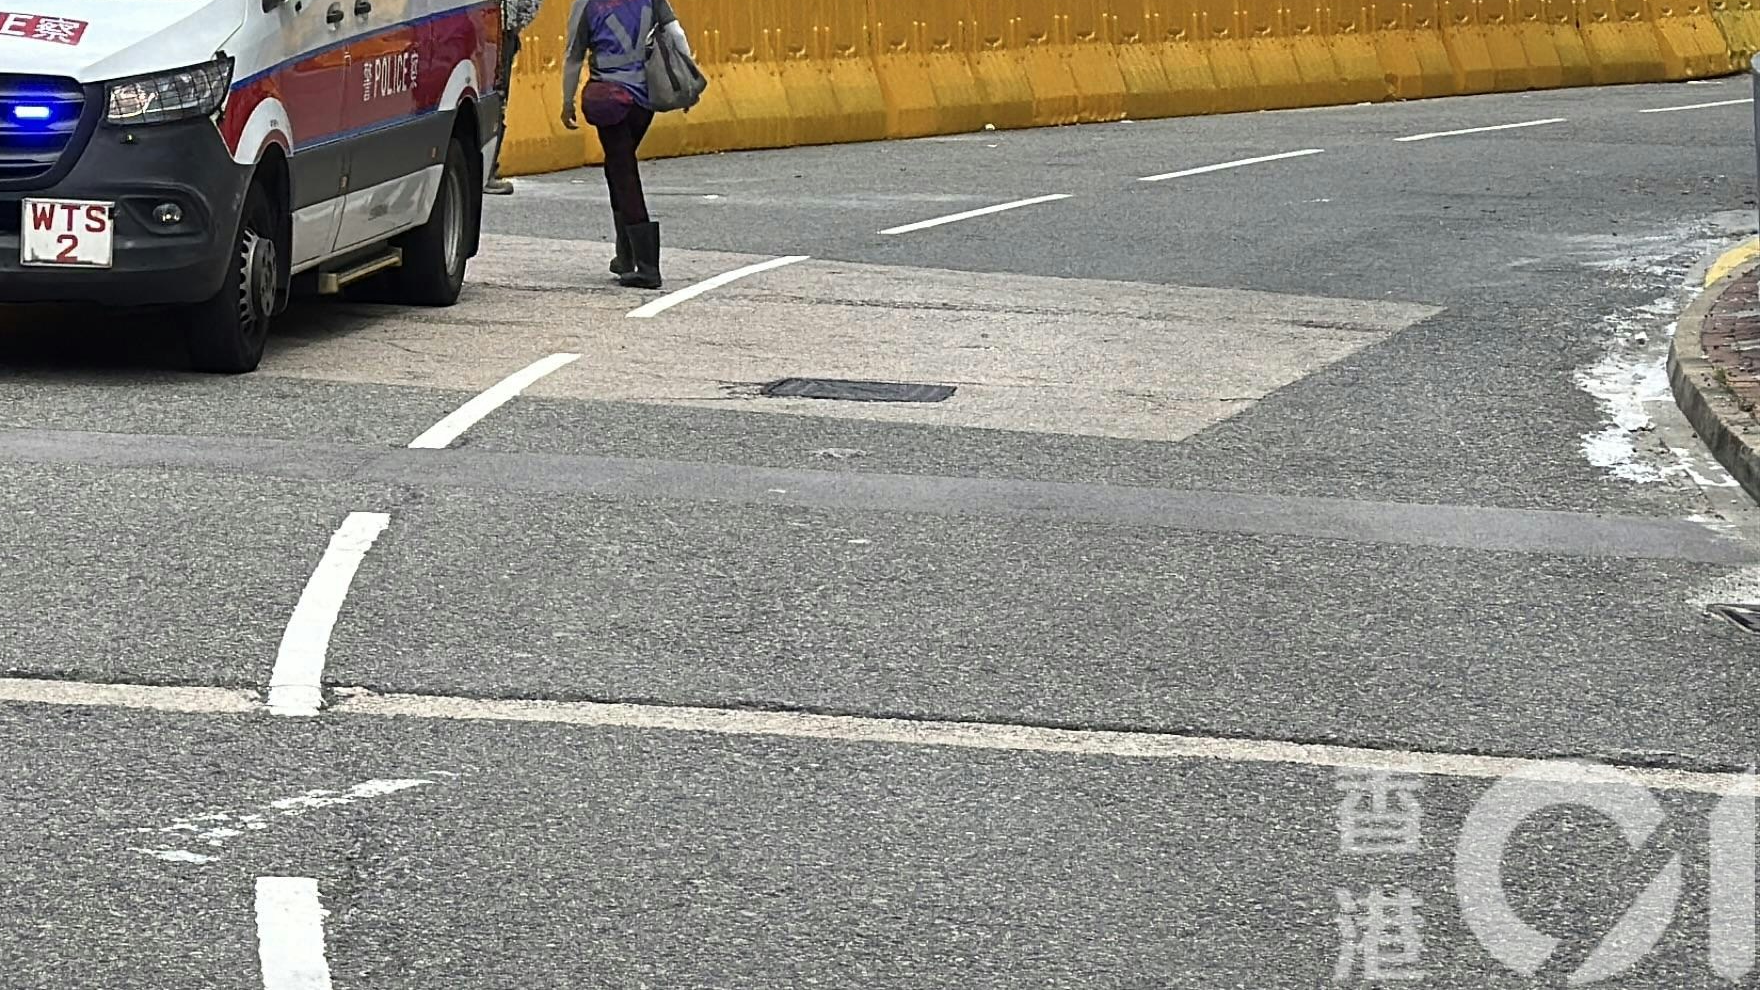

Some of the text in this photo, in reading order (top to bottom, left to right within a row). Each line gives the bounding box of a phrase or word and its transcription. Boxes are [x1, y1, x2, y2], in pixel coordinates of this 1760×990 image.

[35, 16, 80, 43] 察
[374, 51, 409, 99] POLICE
[32, 203, 107, 232] WTS
[56, 234, 79, 262] 2
